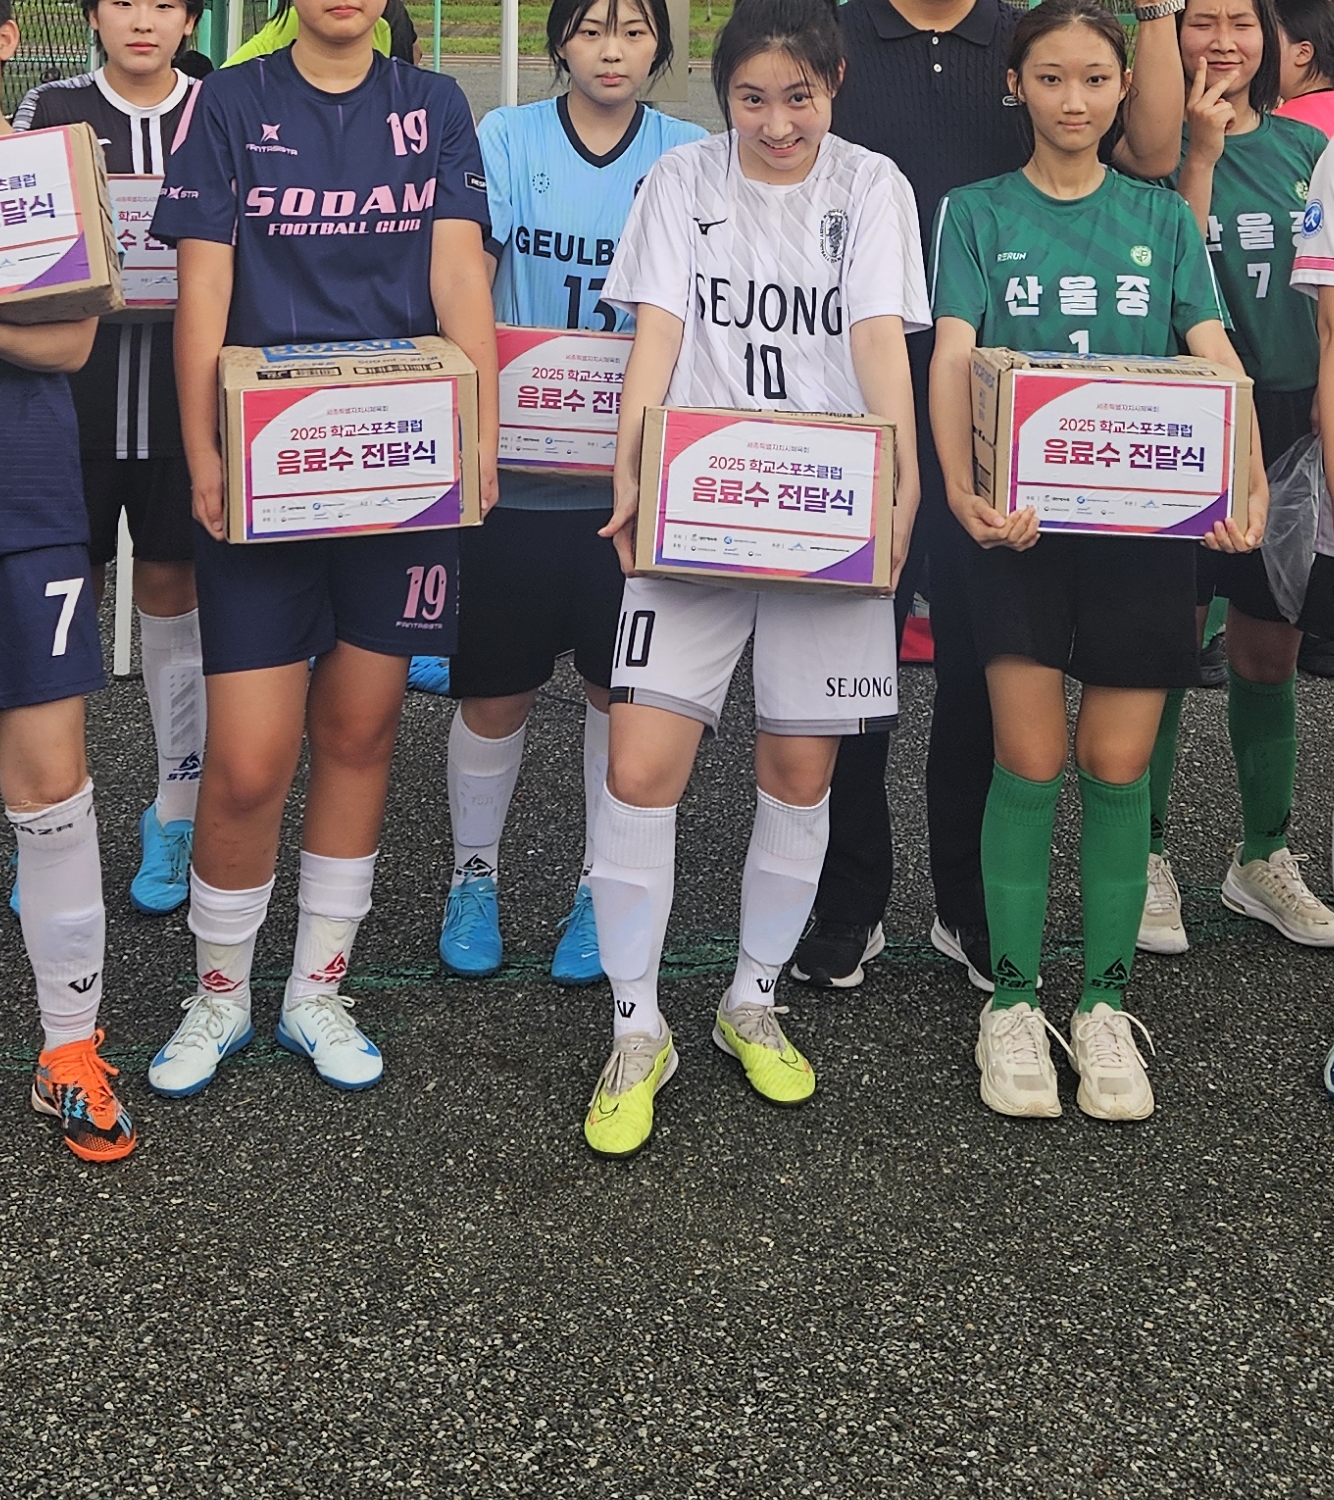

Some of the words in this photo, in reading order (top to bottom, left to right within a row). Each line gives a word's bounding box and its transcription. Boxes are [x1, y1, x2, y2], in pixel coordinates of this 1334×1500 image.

[386, 108, 428, 156] 19
[244, 177, 437, 217] SODAM
[268, 221, 370, 236] FOOTBALL
[374, 218, 421, 233] CLUB
[515, 225, 620, 267] GEULB
[1005, 275, 1151, 317] 산울중
[1247, 262, 1271, 298] 7
[695, 272, 842, 336] SEJONG
[532, 367, 564, 381] 2025
[568, 369, 625, 384] 학교스포츠
[744, 342, 787, 399] 10
[517, 385, 586, 412] 음료수
[290, 426, 327, 441] 2025
[331, 419, 423, 438] 학교스포츠클럽
[1059, 418, 1096, 432] 2025
[1100, 420, 1193, 438] 학교스포츠클럽
[277, 446, 354, 476] 음료수
[361, 439, 436, 469] 전달식
[708, 456, 746, 471] 2025
[749, 459, 843, 481] 학교스포츠클럽
[1043, 438, 1121, 468] 음료수
[1128, 443, 1206, 472] 전달식
[692, 476, 770, 509] 음료수
[777, 484, 855, 517] 전달식
[403, 564, 447, 620] 19
[44, 577, 84, 657] 7
[825, 676, 893, 698] SEJONG
